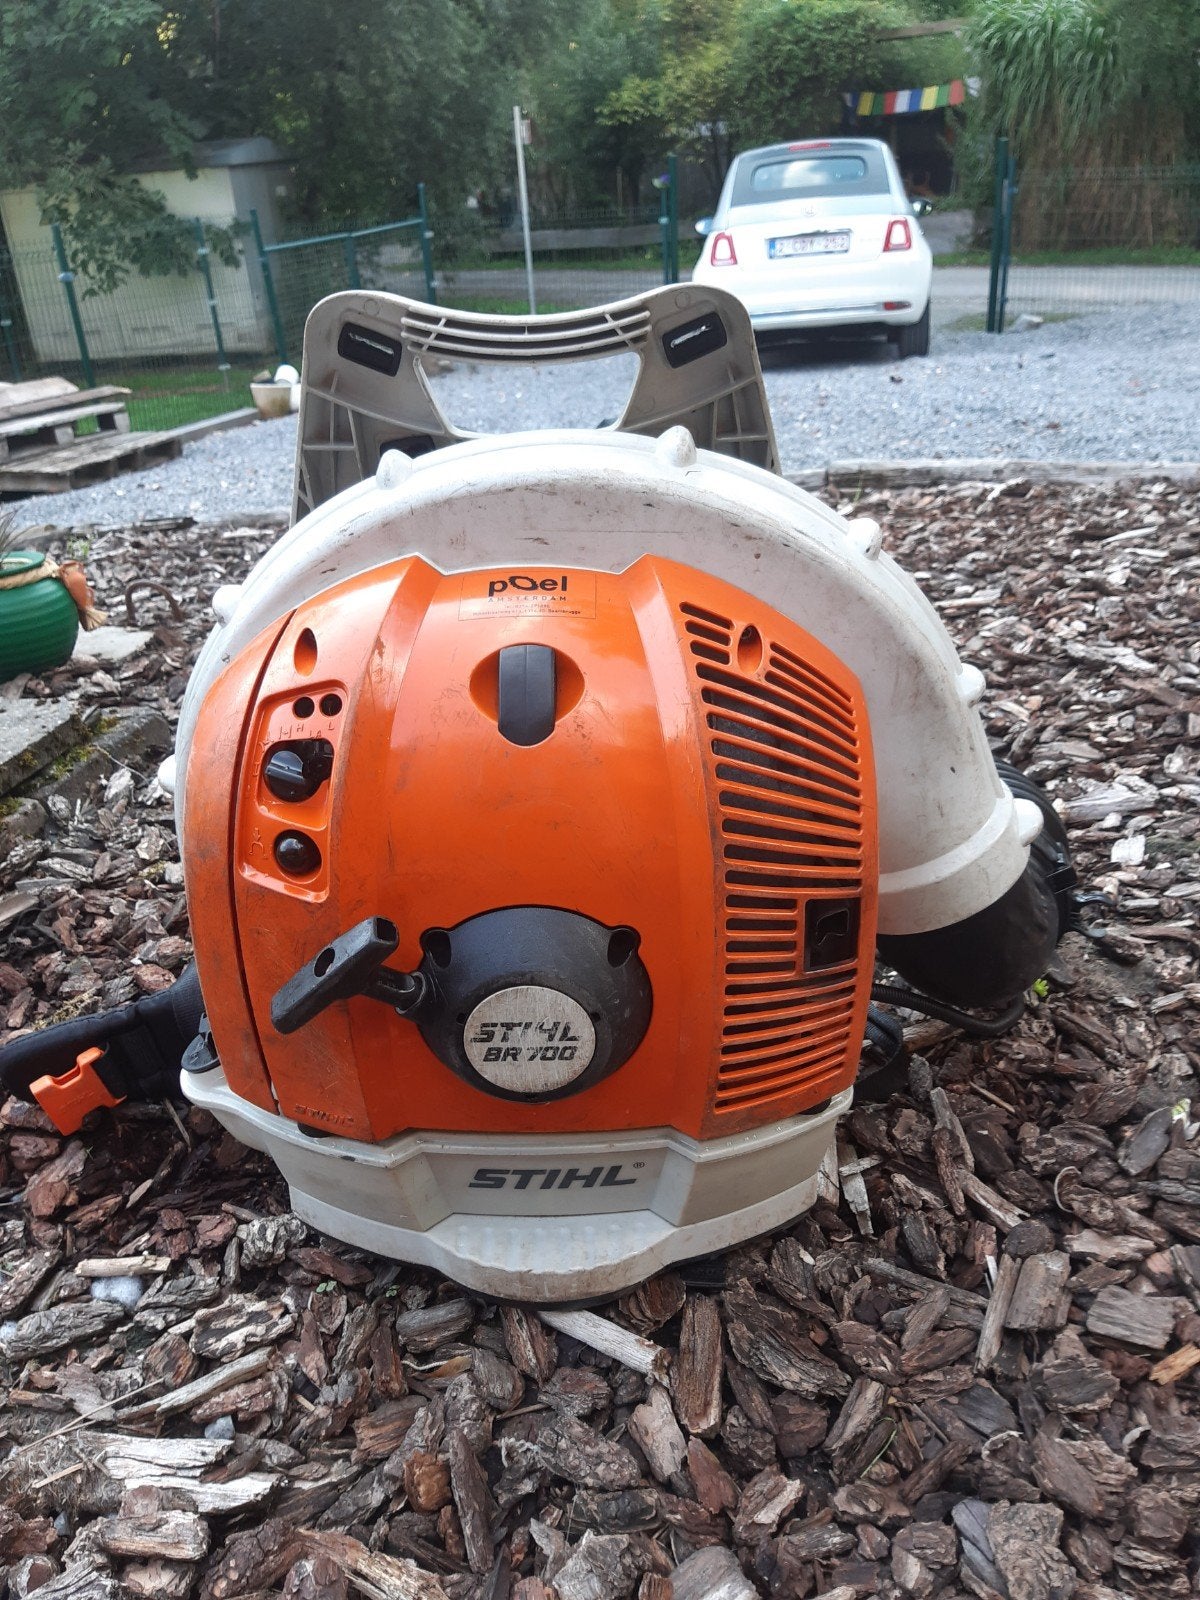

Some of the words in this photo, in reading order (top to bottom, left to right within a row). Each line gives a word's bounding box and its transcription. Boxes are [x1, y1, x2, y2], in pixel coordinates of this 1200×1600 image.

[487, 595, 567, 603] AMSTERDAM
[470, 1021, 581, 1043] STIHL
[482, 1046, 522, 1062] BR
[527, 1045, 578, 1062] 700
[468, 1164, 638, 1190] STIHL
